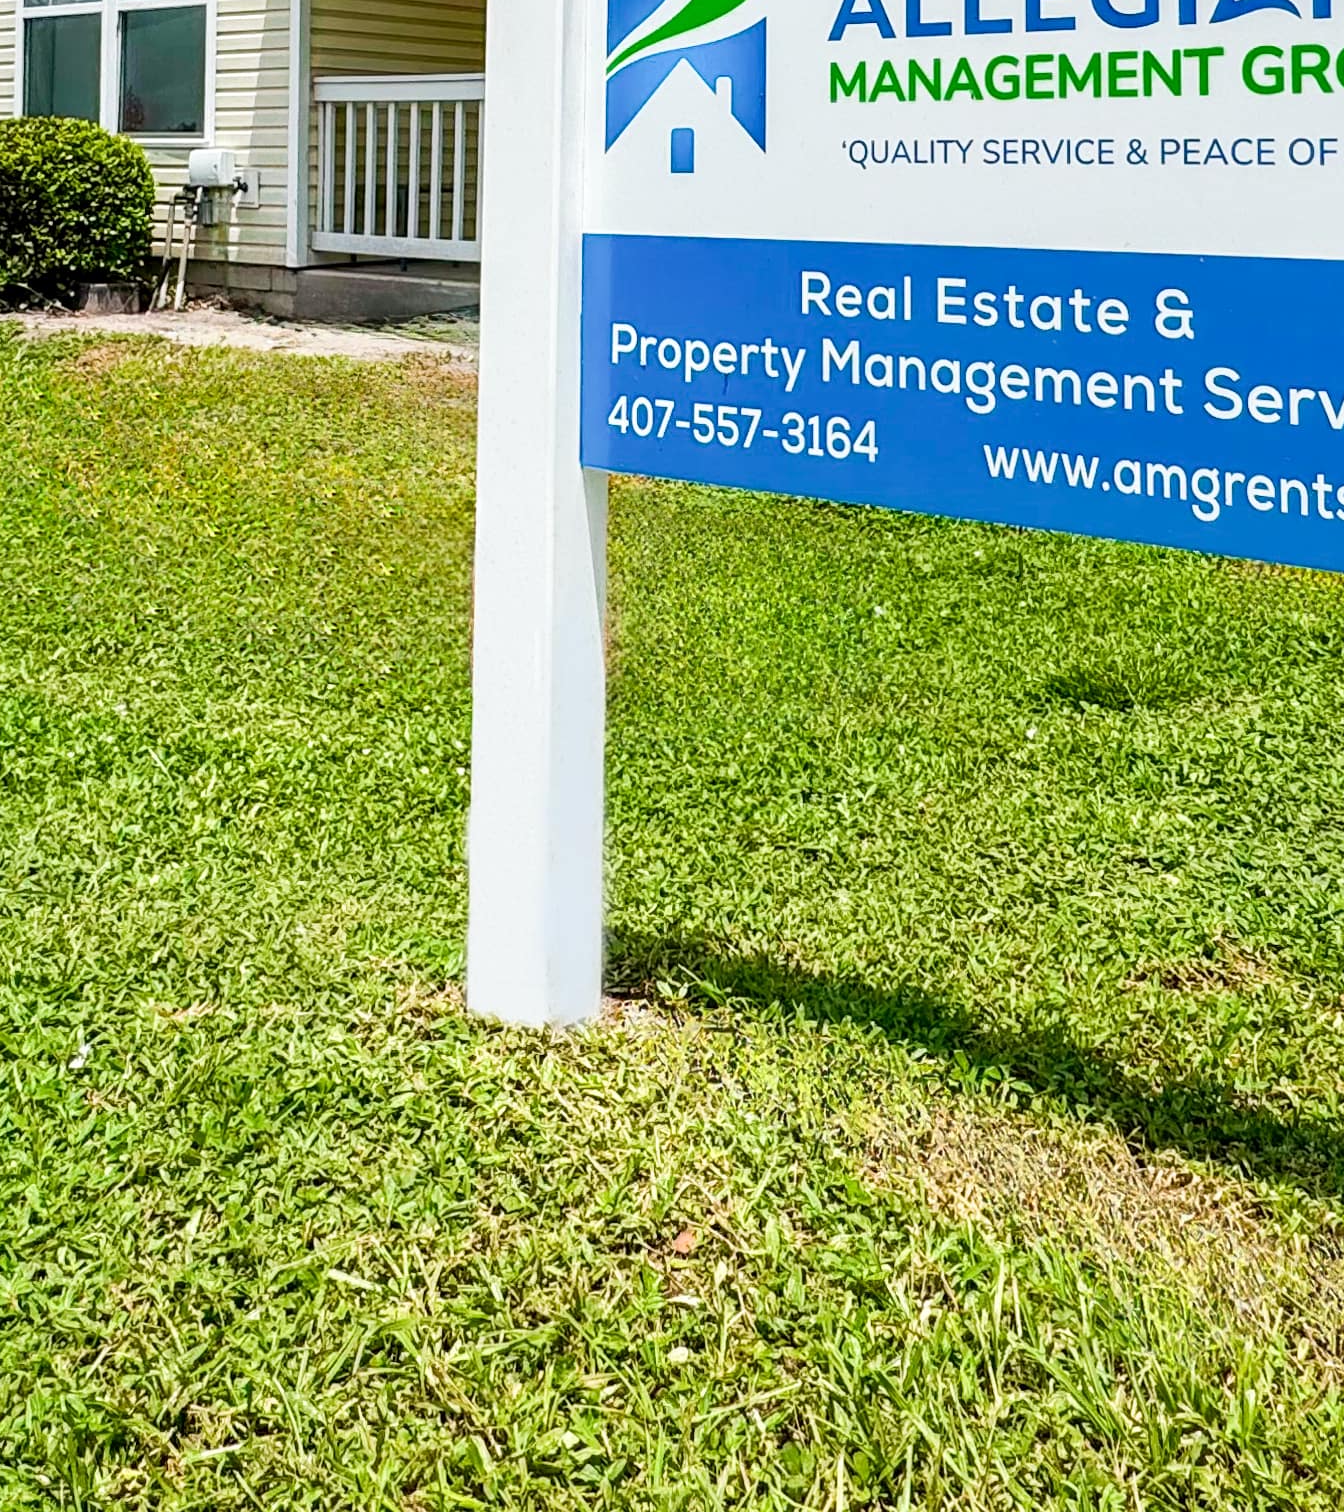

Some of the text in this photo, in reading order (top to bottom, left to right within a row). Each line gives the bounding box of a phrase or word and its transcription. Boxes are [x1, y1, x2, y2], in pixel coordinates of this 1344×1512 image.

[829, 45, 1226, 104] MANAGEMENT
[982, 138, 1115, 166] SERVICE
[1126, 138, 1149, 166] &
[1160, 138, 1276, 166] PEACE
[1288, 137, 1339, 167] OF
[801, 271, 1195, 340] Real Estate &
[611, 323, 806, 393] Property
[822, 338, 1184, 415] Management
[607, 395, 879, 463] 407-557-3164
